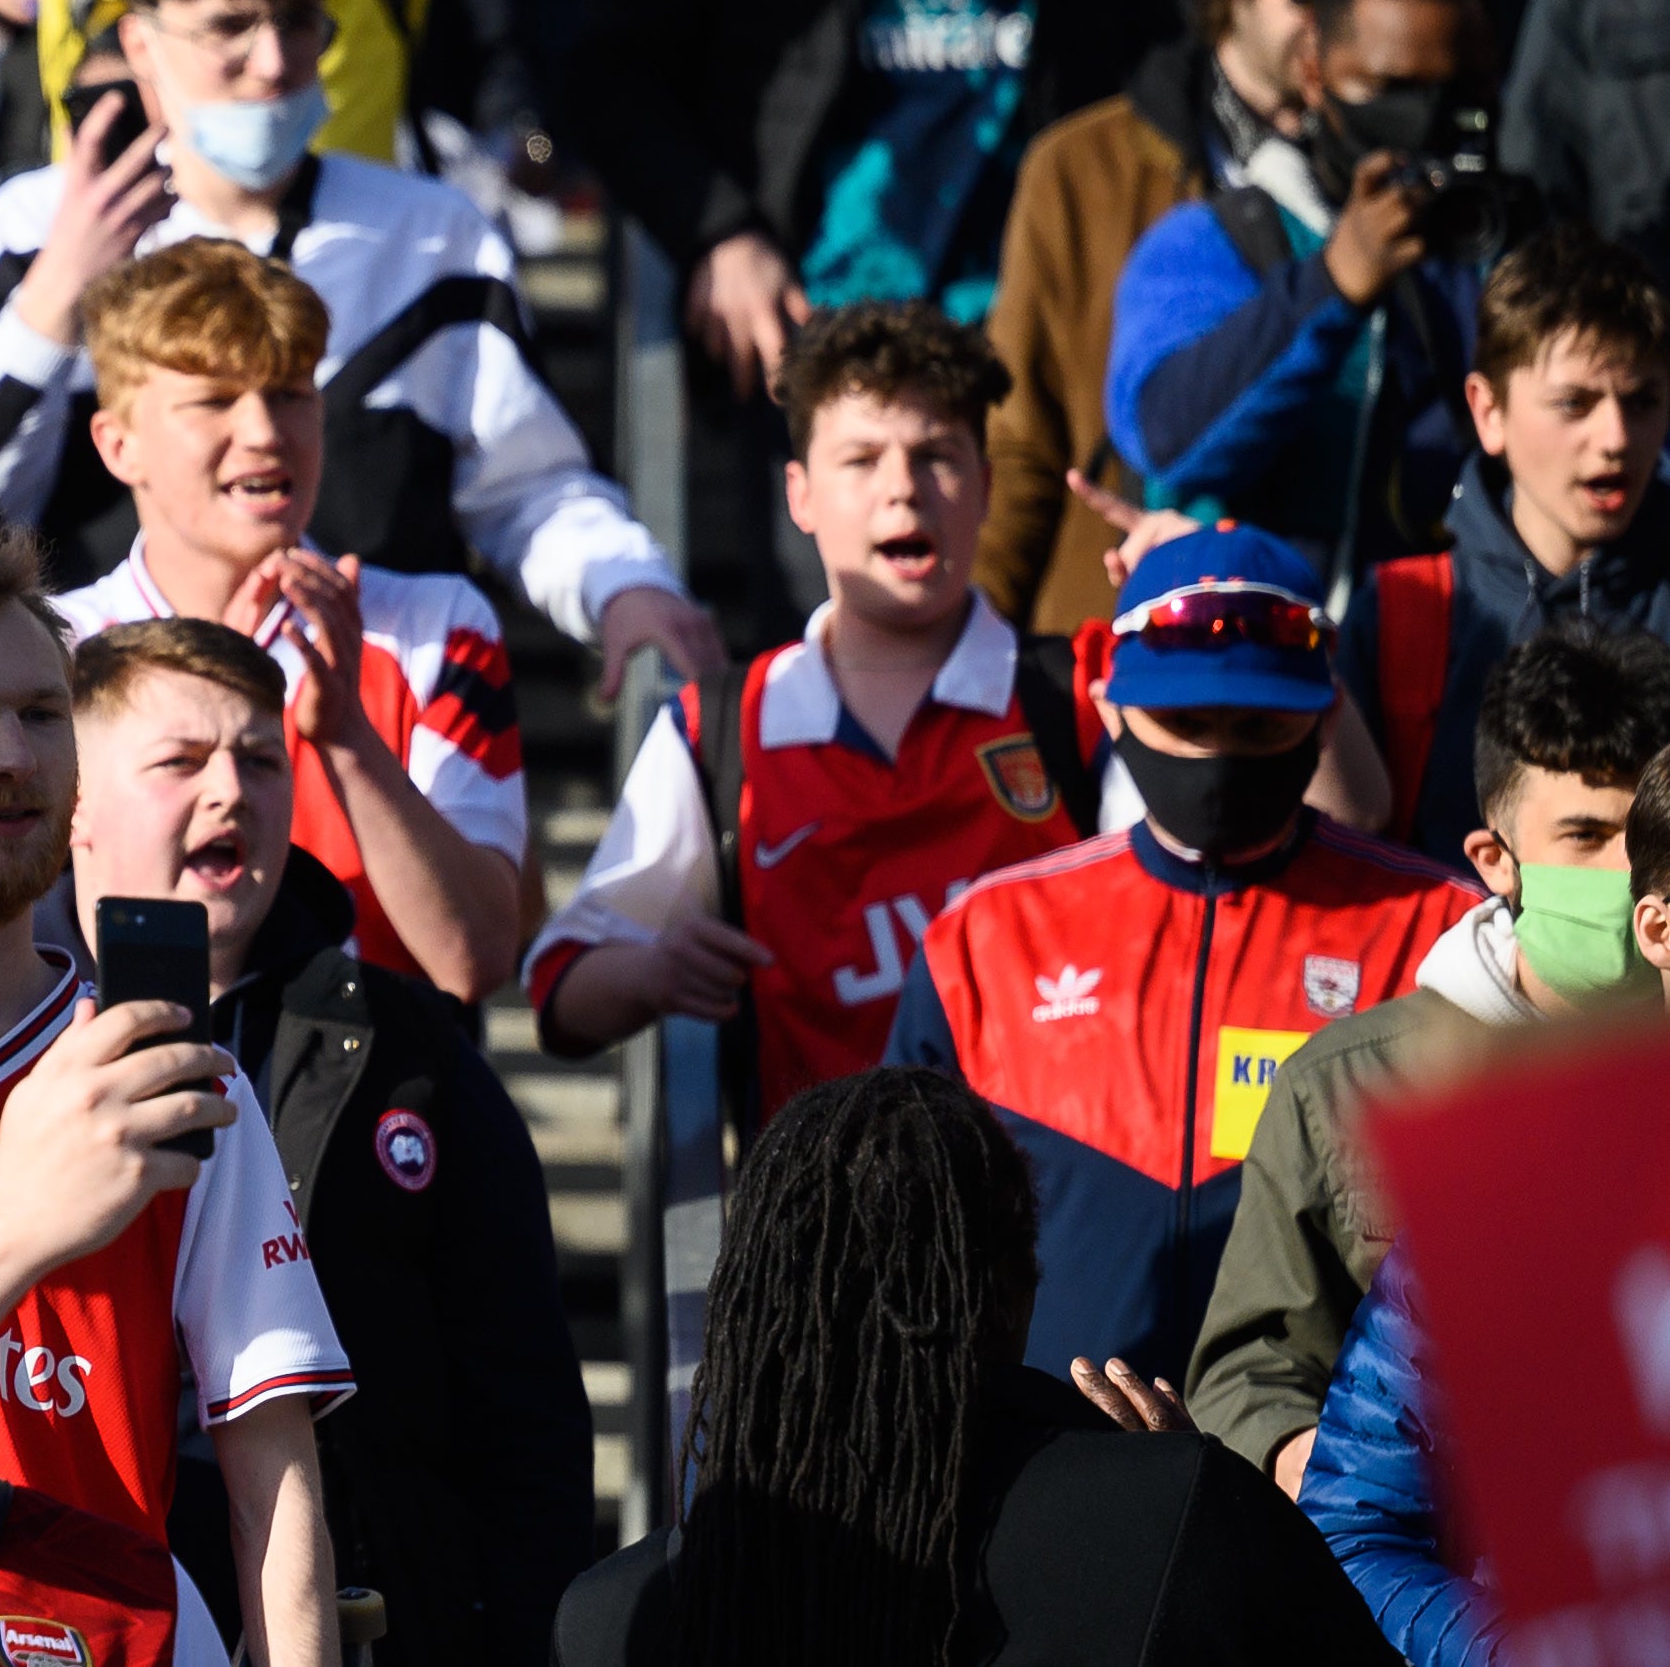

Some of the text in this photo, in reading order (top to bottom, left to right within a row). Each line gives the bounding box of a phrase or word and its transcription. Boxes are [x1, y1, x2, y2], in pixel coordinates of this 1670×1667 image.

[832, 879, 969, 998] JV
[1032, 997, 1100, 1023] adidas
[6, 1629, 73, 1652] Arsenal
